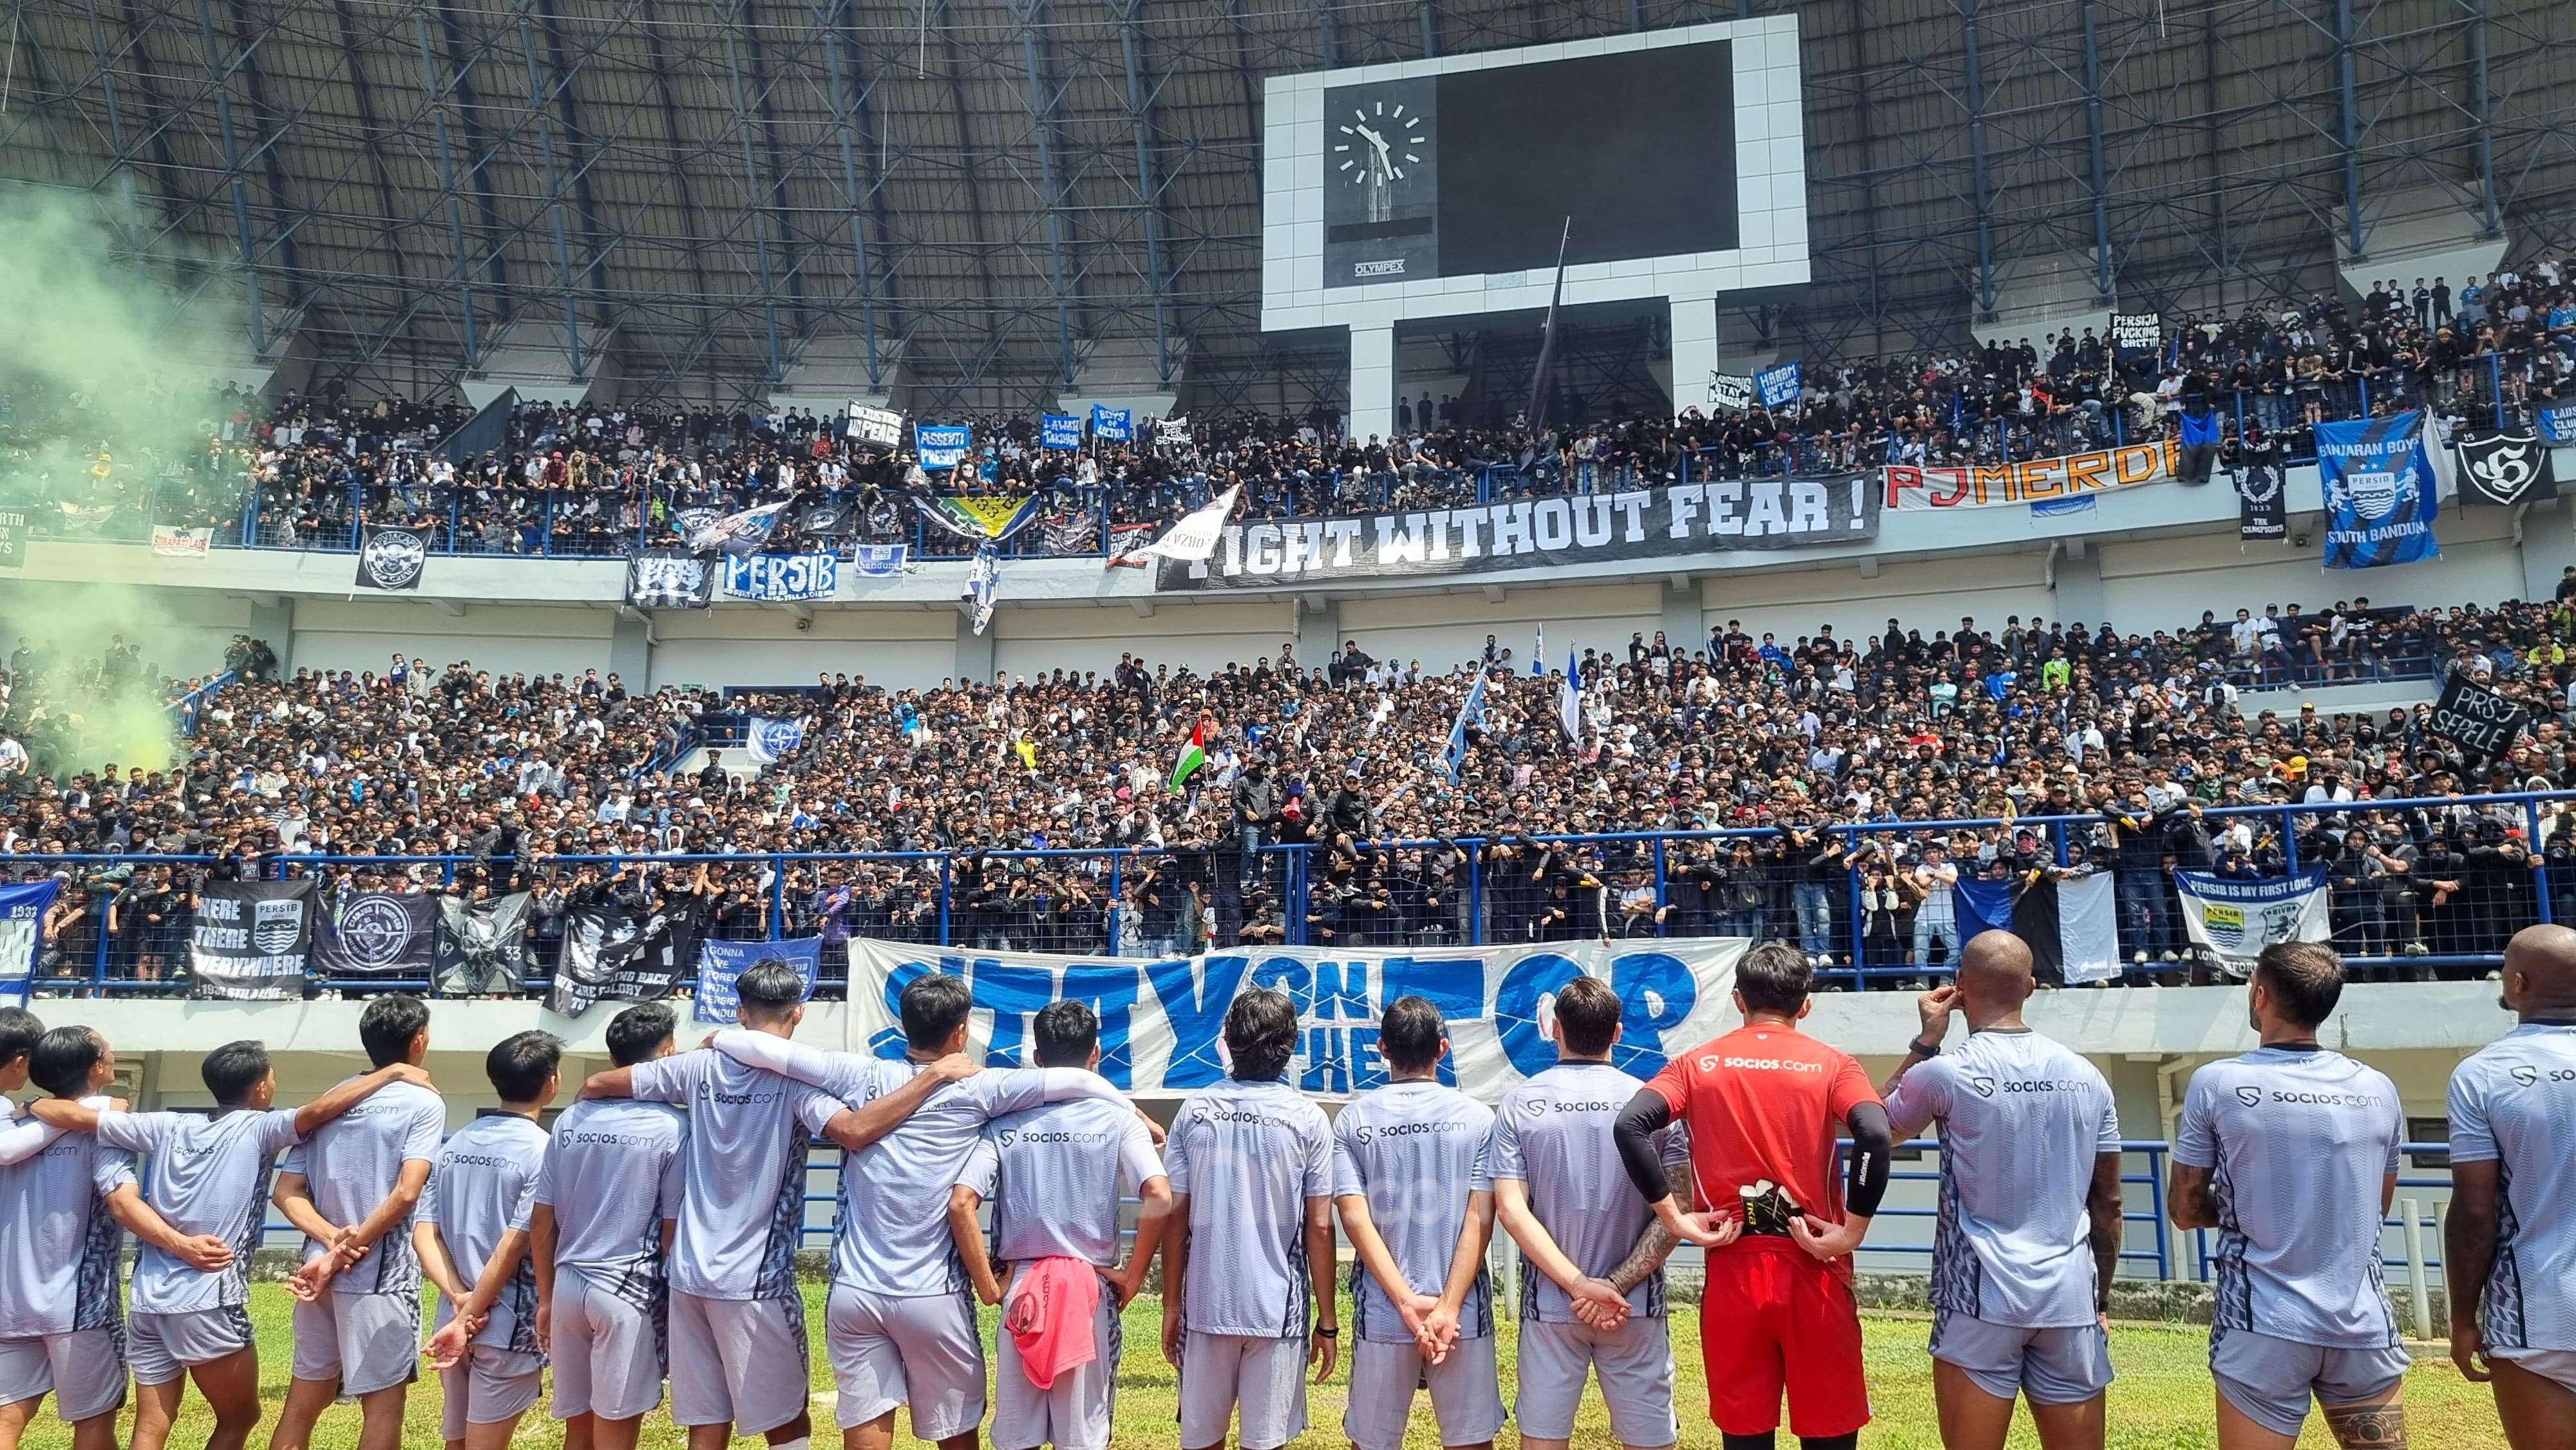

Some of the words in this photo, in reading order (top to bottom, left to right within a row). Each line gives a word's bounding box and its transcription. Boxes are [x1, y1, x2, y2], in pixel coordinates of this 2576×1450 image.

[1355, 261, 1404, 274] OLYMPEX
[2114, 313, 2159, 327] PERSIJA
[2112, 325, 2161, 339] FUCKING
[1710, 372, 1752, 393] BANDUNG
[1759, 364, 1797, 388] HARAM
[1715, 384, 1741, 397] STAY
[1765, 378, 1799, 396] UNTUK
[1709, 388, 1750, 410] HIGH
[1098, 410, 1126, 421] BOYS
[1164, 428, 1182, 437] PER
[2463, 433, 2475, 442] 19
[2353, 475, 2389, 484] PERSIB
[1376, 489, 1650, 565] WITHOUT
[1668, 481, 1829, 539] FEAR
[2370, 522, 2428, 542] BANDUN
[727, 554, 836, 596] PERSIB
[2452, 686, 2519, 723] PRSJ
[2432, 709, 2506, 752] SEPELE
[2190, 880, 2228, 896] PERSIB
[2228, 885, 2240, 897] IS
[2241, 886, 2257, 898] MY
[2260, 882, 2288, 897] FIRST
[2289, 876, 2313, 892] LOVE
[260, 903, 298, 914] PERSIB
[194, 925, 249, 949] THERE
[504, 945, 522, 961] 33
[709, 946, 744, 958] GONNA
[708, 959, 729, 969] LIVE
[636, 972, 672, 986] BACK
[703, 982, 728, 993] WITH
[701, 993, 737, 1006] PERSIB
